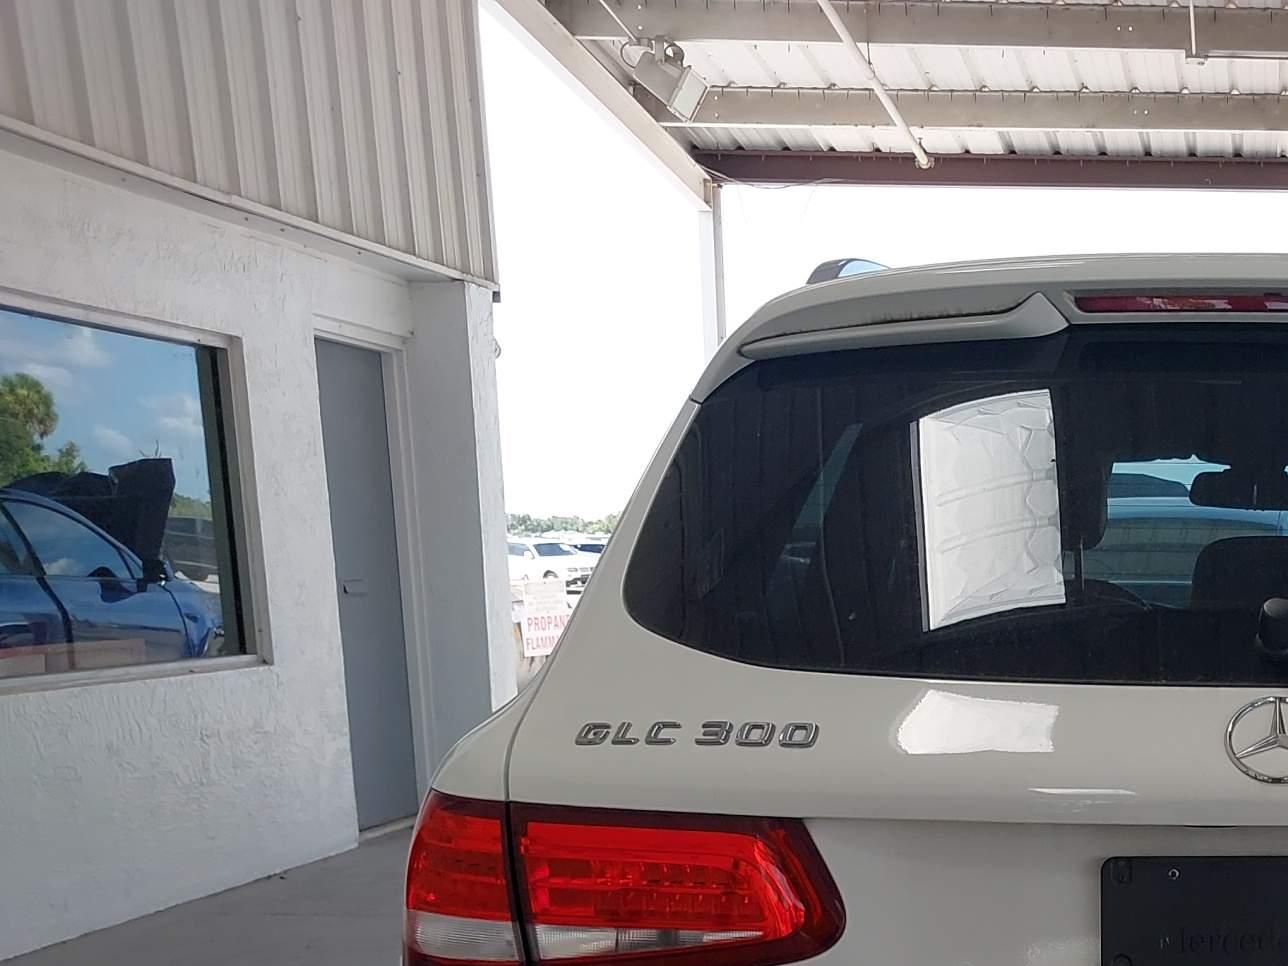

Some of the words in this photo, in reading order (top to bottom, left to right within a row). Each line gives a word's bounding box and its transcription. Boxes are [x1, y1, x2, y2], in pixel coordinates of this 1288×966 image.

[527, 614, 570, 632] PROPAN
[526, 636, 558, 651] FLAMM
[575, 721, 682, 745] GLC
[694, 721, 820, 748] 300
